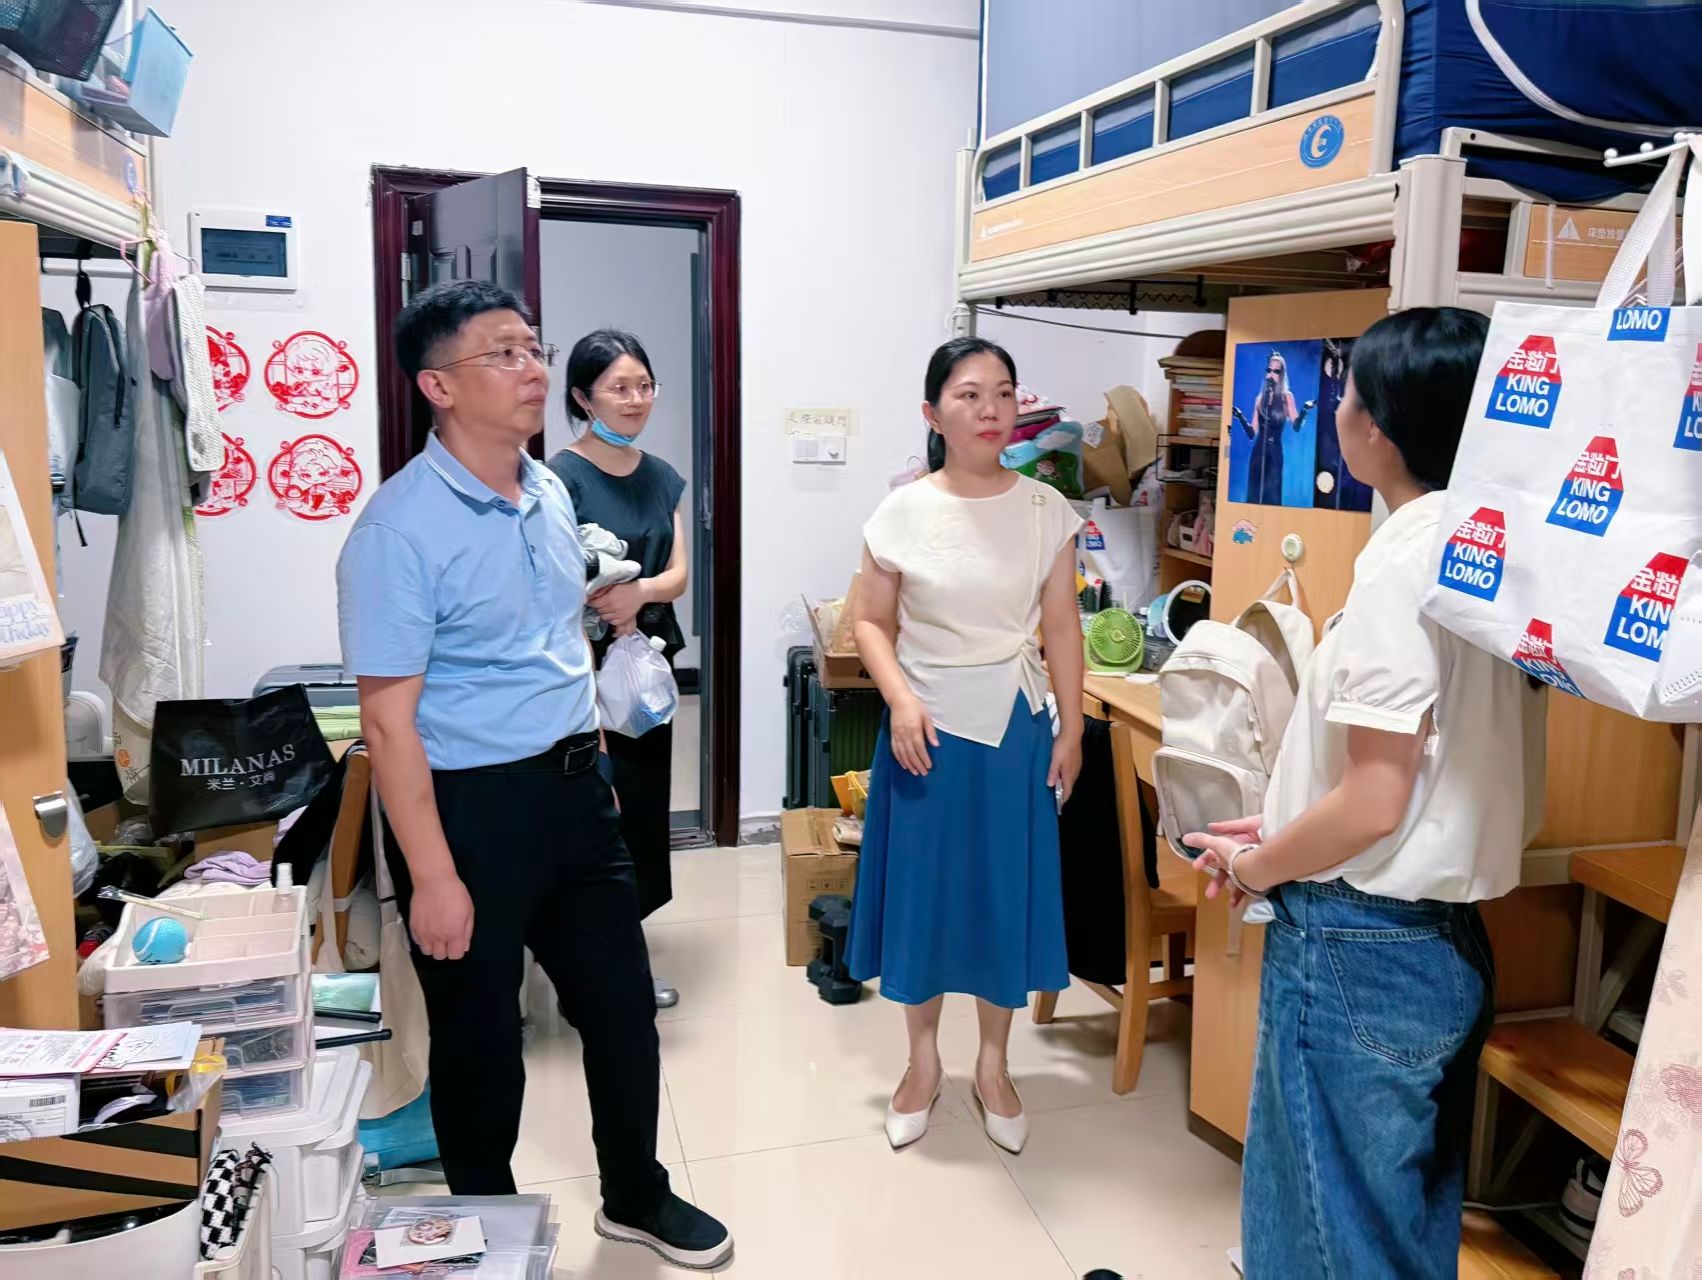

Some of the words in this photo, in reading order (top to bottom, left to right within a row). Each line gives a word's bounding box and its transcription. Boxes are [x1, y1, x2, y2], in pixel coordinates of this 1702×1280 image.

[1615, 309, 1662, 331] LOMO
[1506, 373, 1551, 396] KING
[1495, 392, 1550, 418] LOMO
[1569, 476, 1612, 503] KING
[1555, 497, 1609, 525] LOMO
[1452, 540, 1499, 569] KING
[1444, 559, 1496, 590] LOMO
[1630, 566, 1680, 601] 金粒
[1629, 594, 1674, 626] KIN
[1616, 616, 1667, 651] LOM
[1539, 672, 1584, 698] OMO
[179, 743, 296, 777] MILANAS
